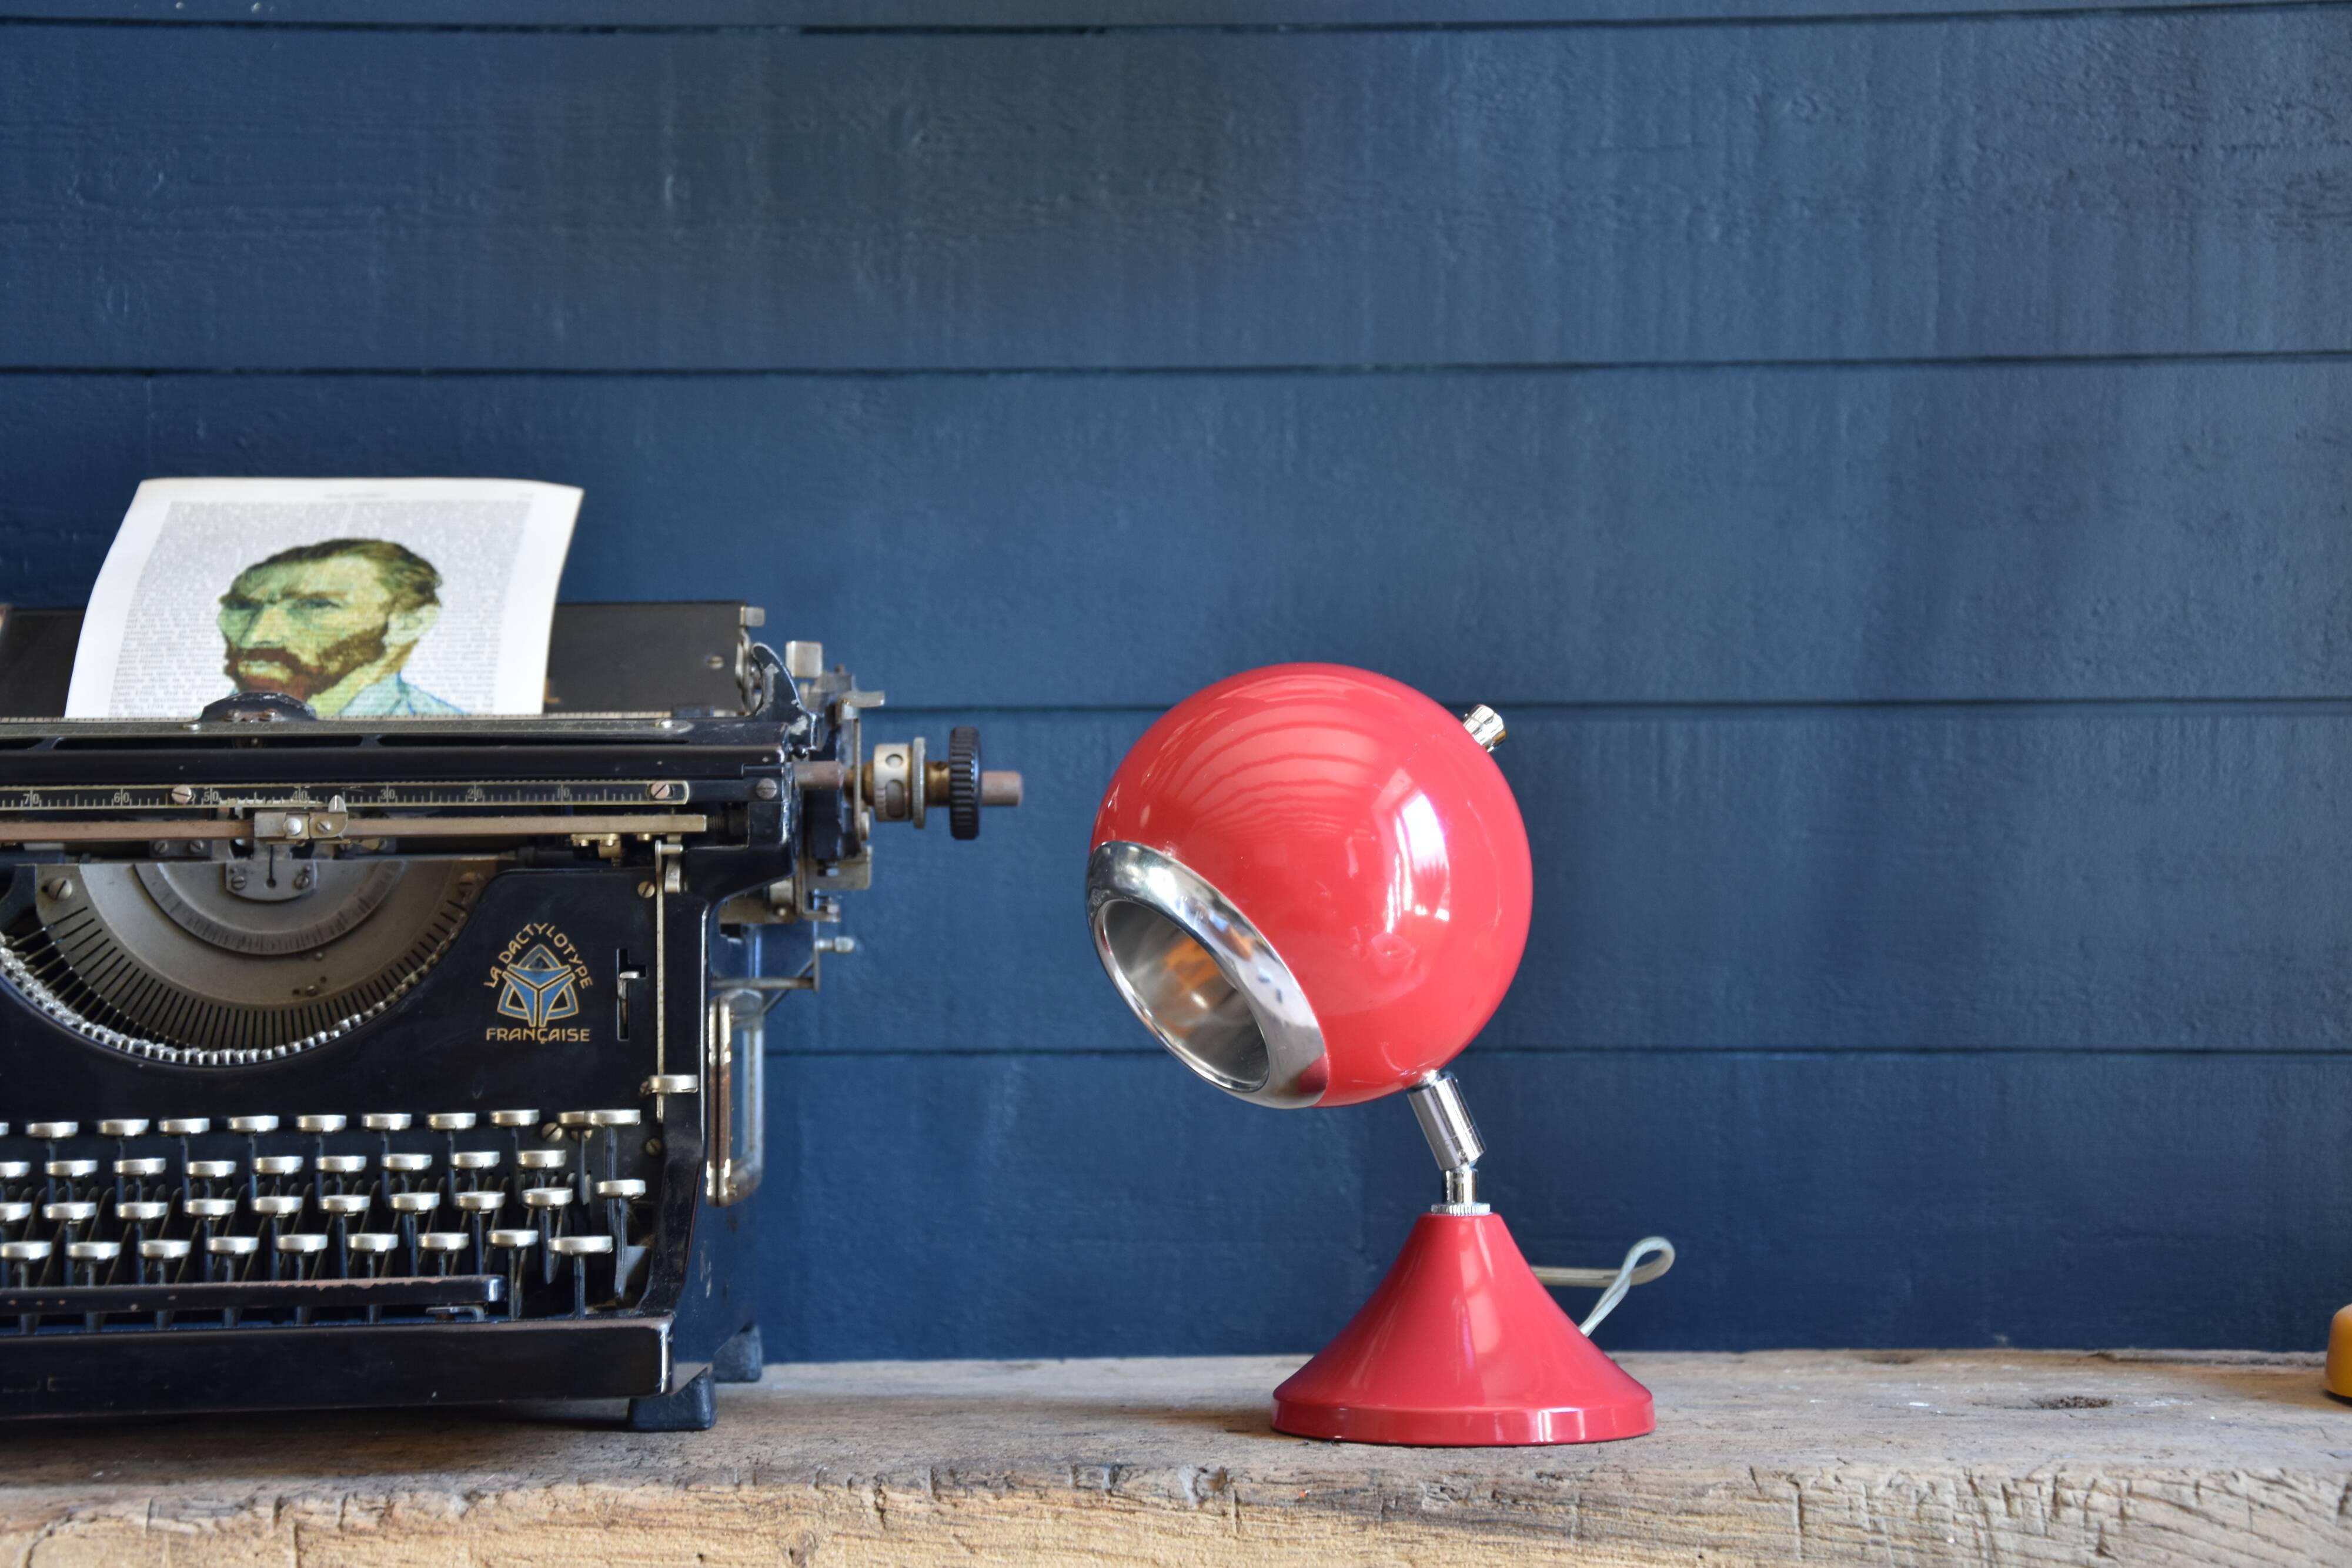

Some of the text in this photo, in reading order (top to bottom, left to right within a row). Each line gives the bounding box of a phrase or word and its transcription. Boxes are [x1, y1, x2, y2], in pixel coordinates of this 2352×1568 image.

[23, 793, 40, 804] 70
[113, 792, 130, 803] 60
[204, 791, 219, 802] 50
[380, 789, 396, 800] 30
[467, 788, 483, 800] 20
[483, 922, 593, 989] LA DACTYLOTYPE
[486, 1027, 590, 1044] FRANÇAISE
